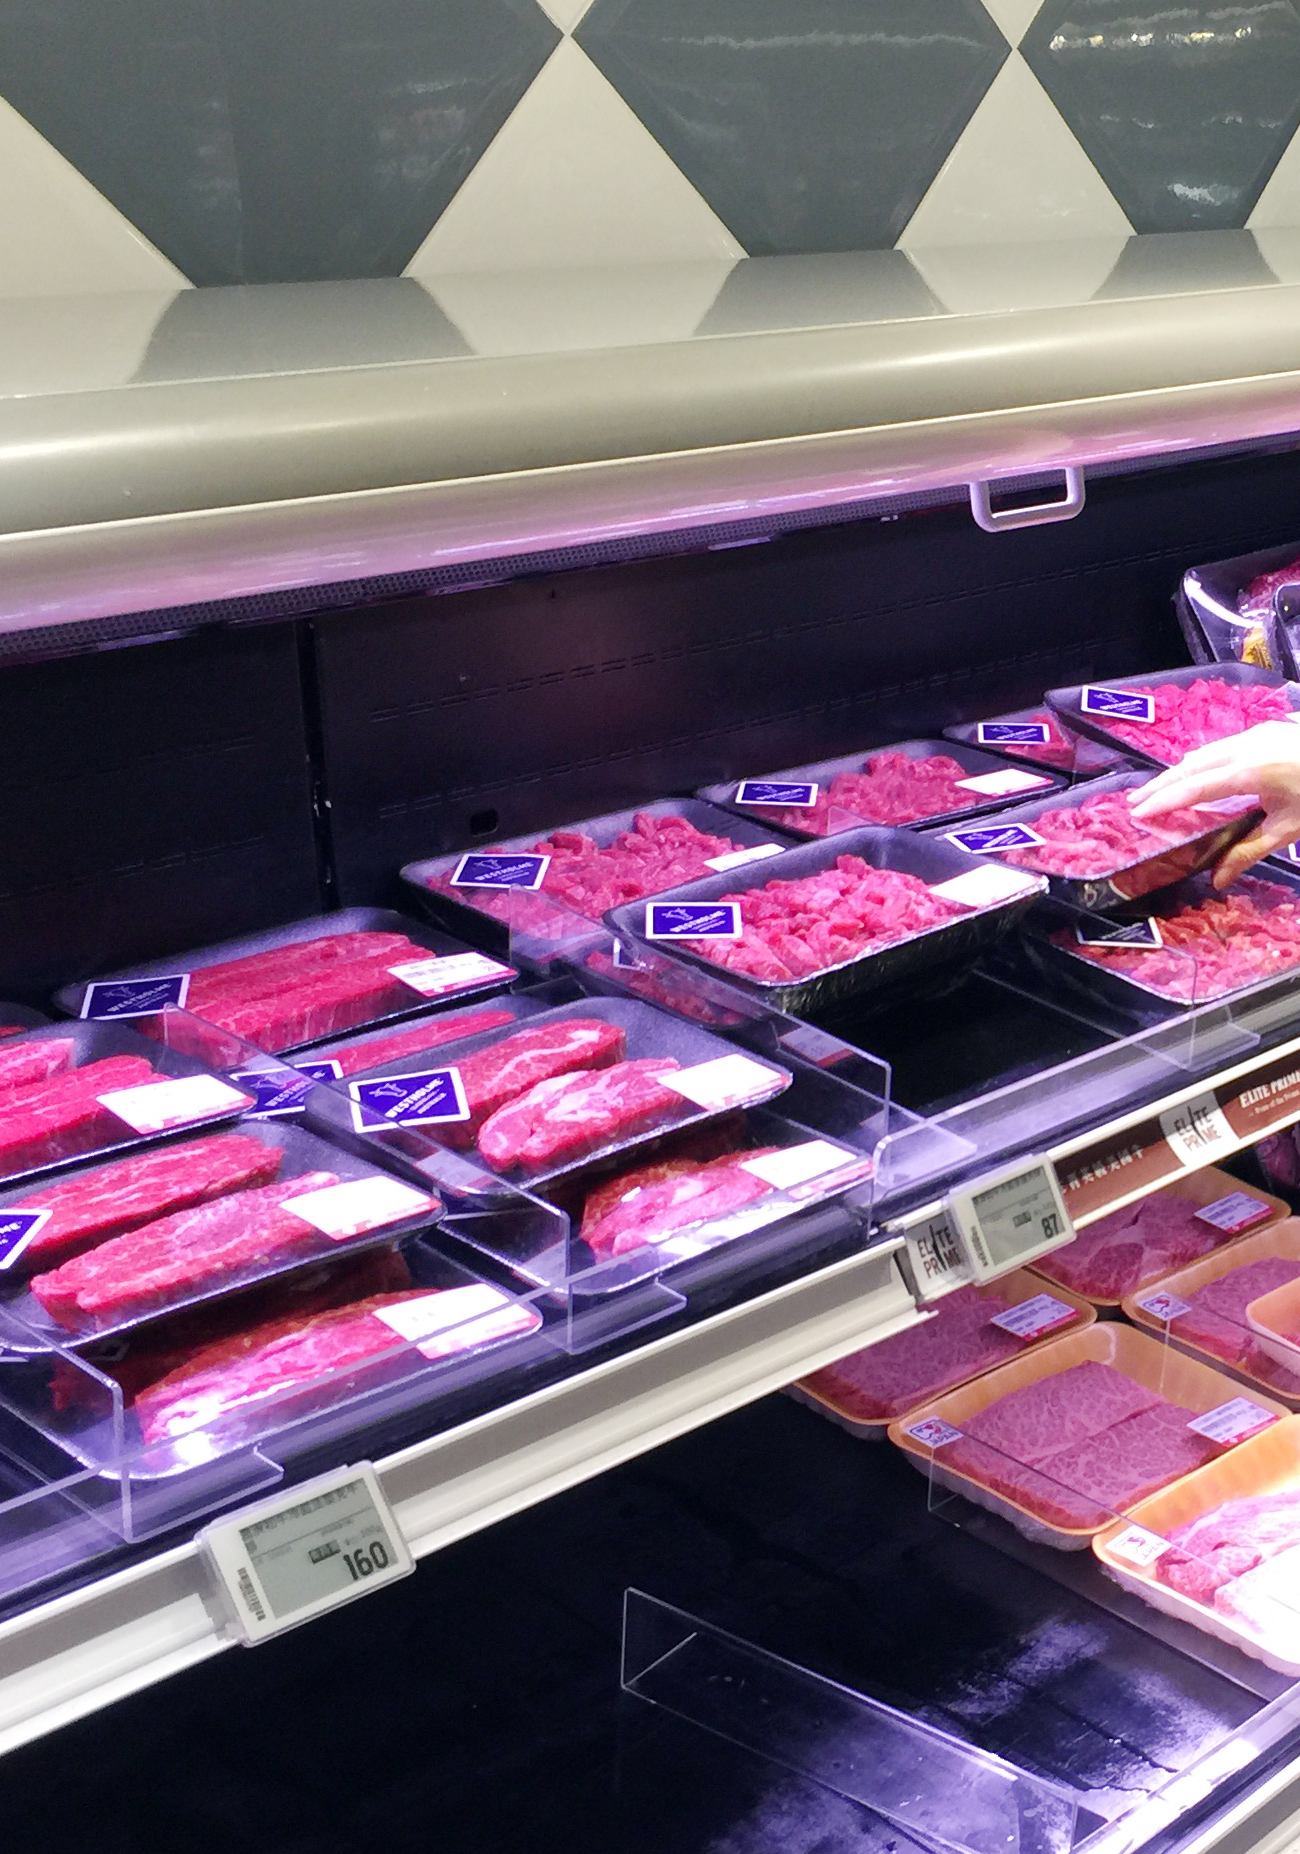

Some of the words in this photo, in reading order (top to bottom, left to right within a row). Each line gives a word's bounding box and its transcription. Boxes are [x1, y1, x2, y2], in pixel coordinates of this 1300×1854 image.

[384, 1077, 445, 1118] WESTHOLME
[1238, 1083, 1271, 1109] ELITE
[1173, 1105, 1213, 1136] ELITE
[1183, 1123, 1222, 1151] PRIME
[916, 1224, 955, 1259] ELITE
[1041, 1213, 1060, 1239] 87
[343, 1541, 389, 1581] 160
